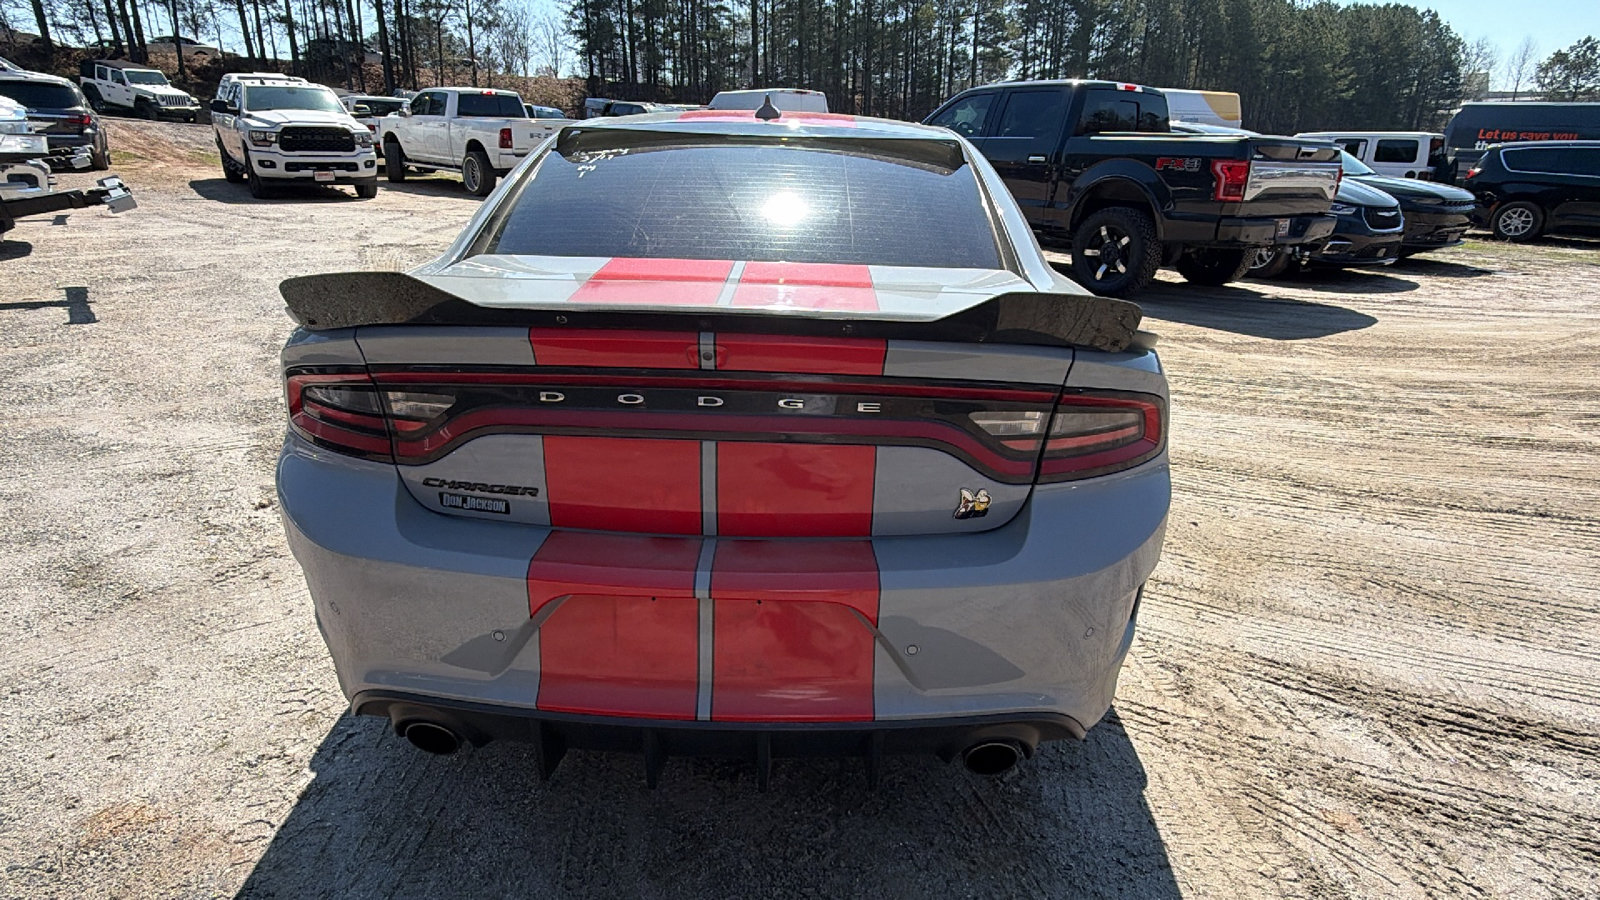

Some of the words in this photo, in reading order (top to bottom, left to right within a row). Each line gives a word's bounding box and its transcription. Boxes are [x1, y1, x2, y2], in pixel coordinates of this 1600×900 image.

[1478, 128, 1500, 140] Let
[1501, 132, 1517, 141] us
[1519, 131, 1550, 141] save
[1552, 132, 1579, 141] you
[539, 391, 881, 413] DODGE
[422, 477, 539, 497] CHARGER
[442, 493, 463, 507] DON
[463, 496, 506, 513] JACKSON
